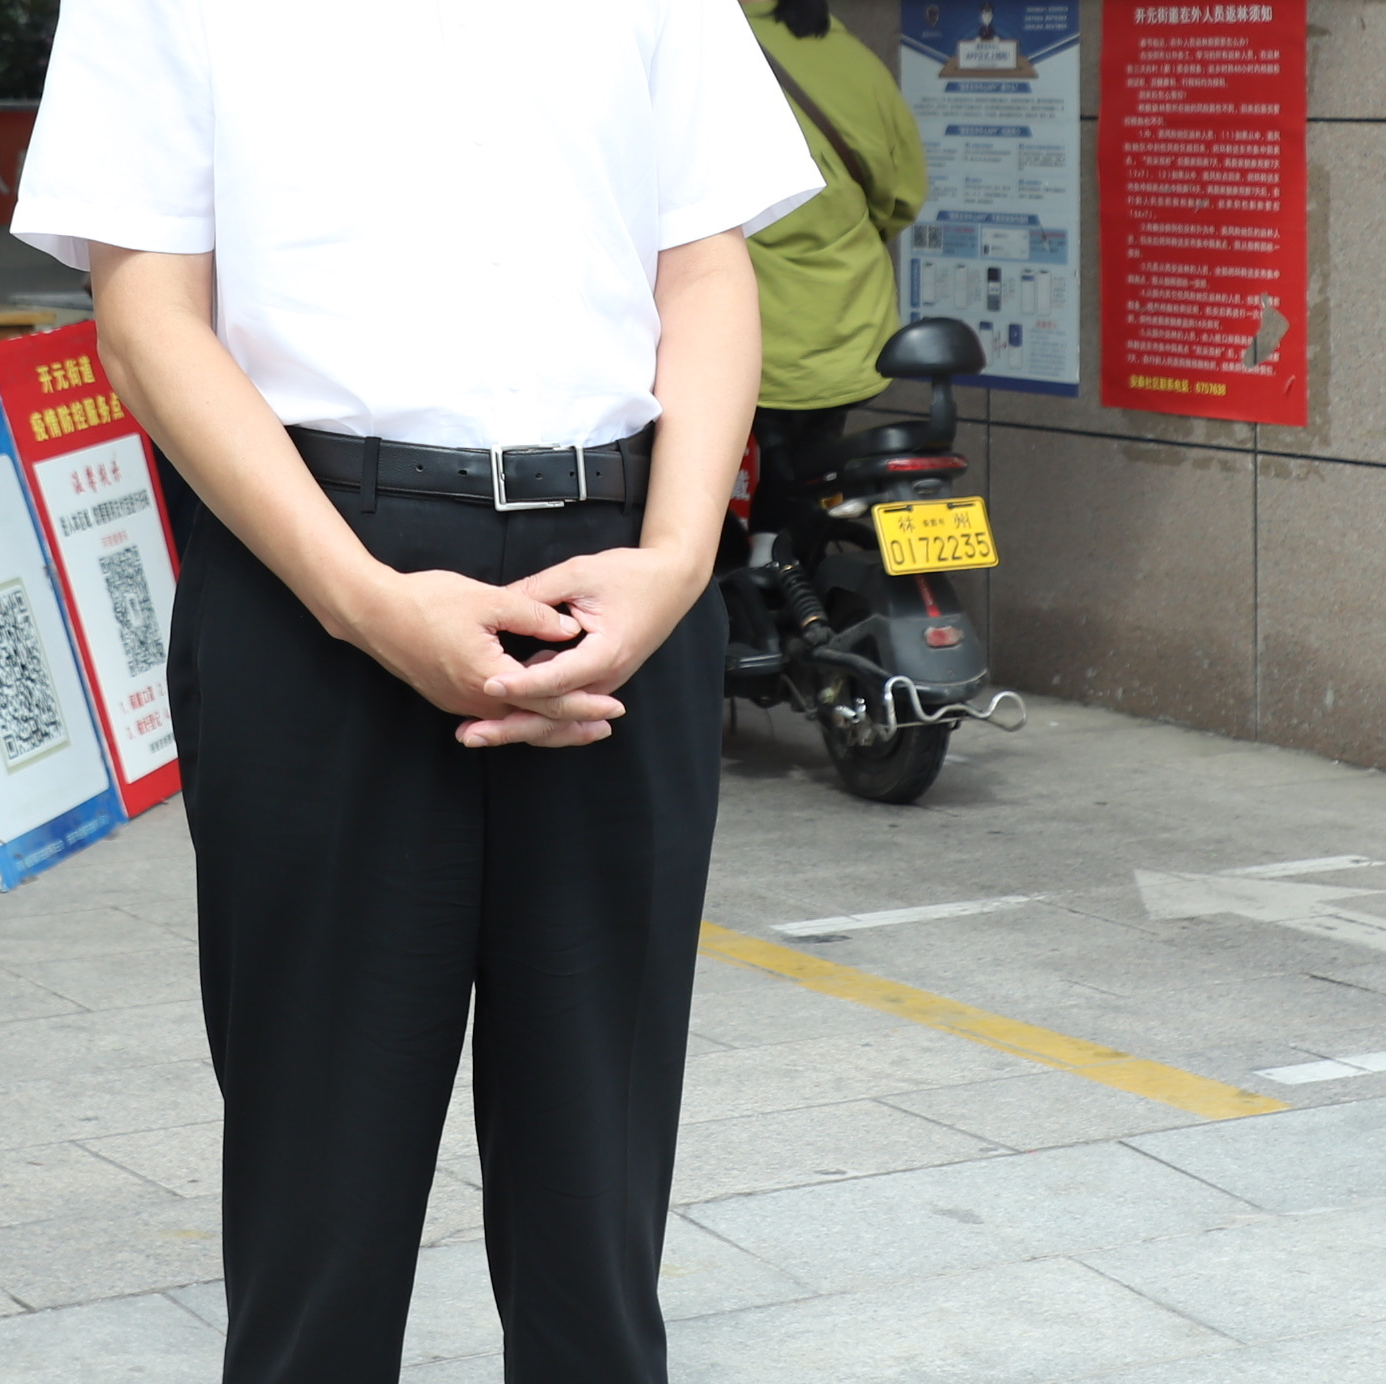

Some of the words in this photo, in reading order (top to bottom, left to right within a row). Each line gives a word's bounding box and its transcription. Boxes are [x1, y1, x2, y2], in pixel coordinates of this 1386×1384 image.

[1134, 5, 1273, 25] 开元街道在外人员返林须知
[36, 355, 96, 394] 开元街道
[29, 391, 125, 442] 疫情防控服务点
[890, 532, 990, 565] 0172235
